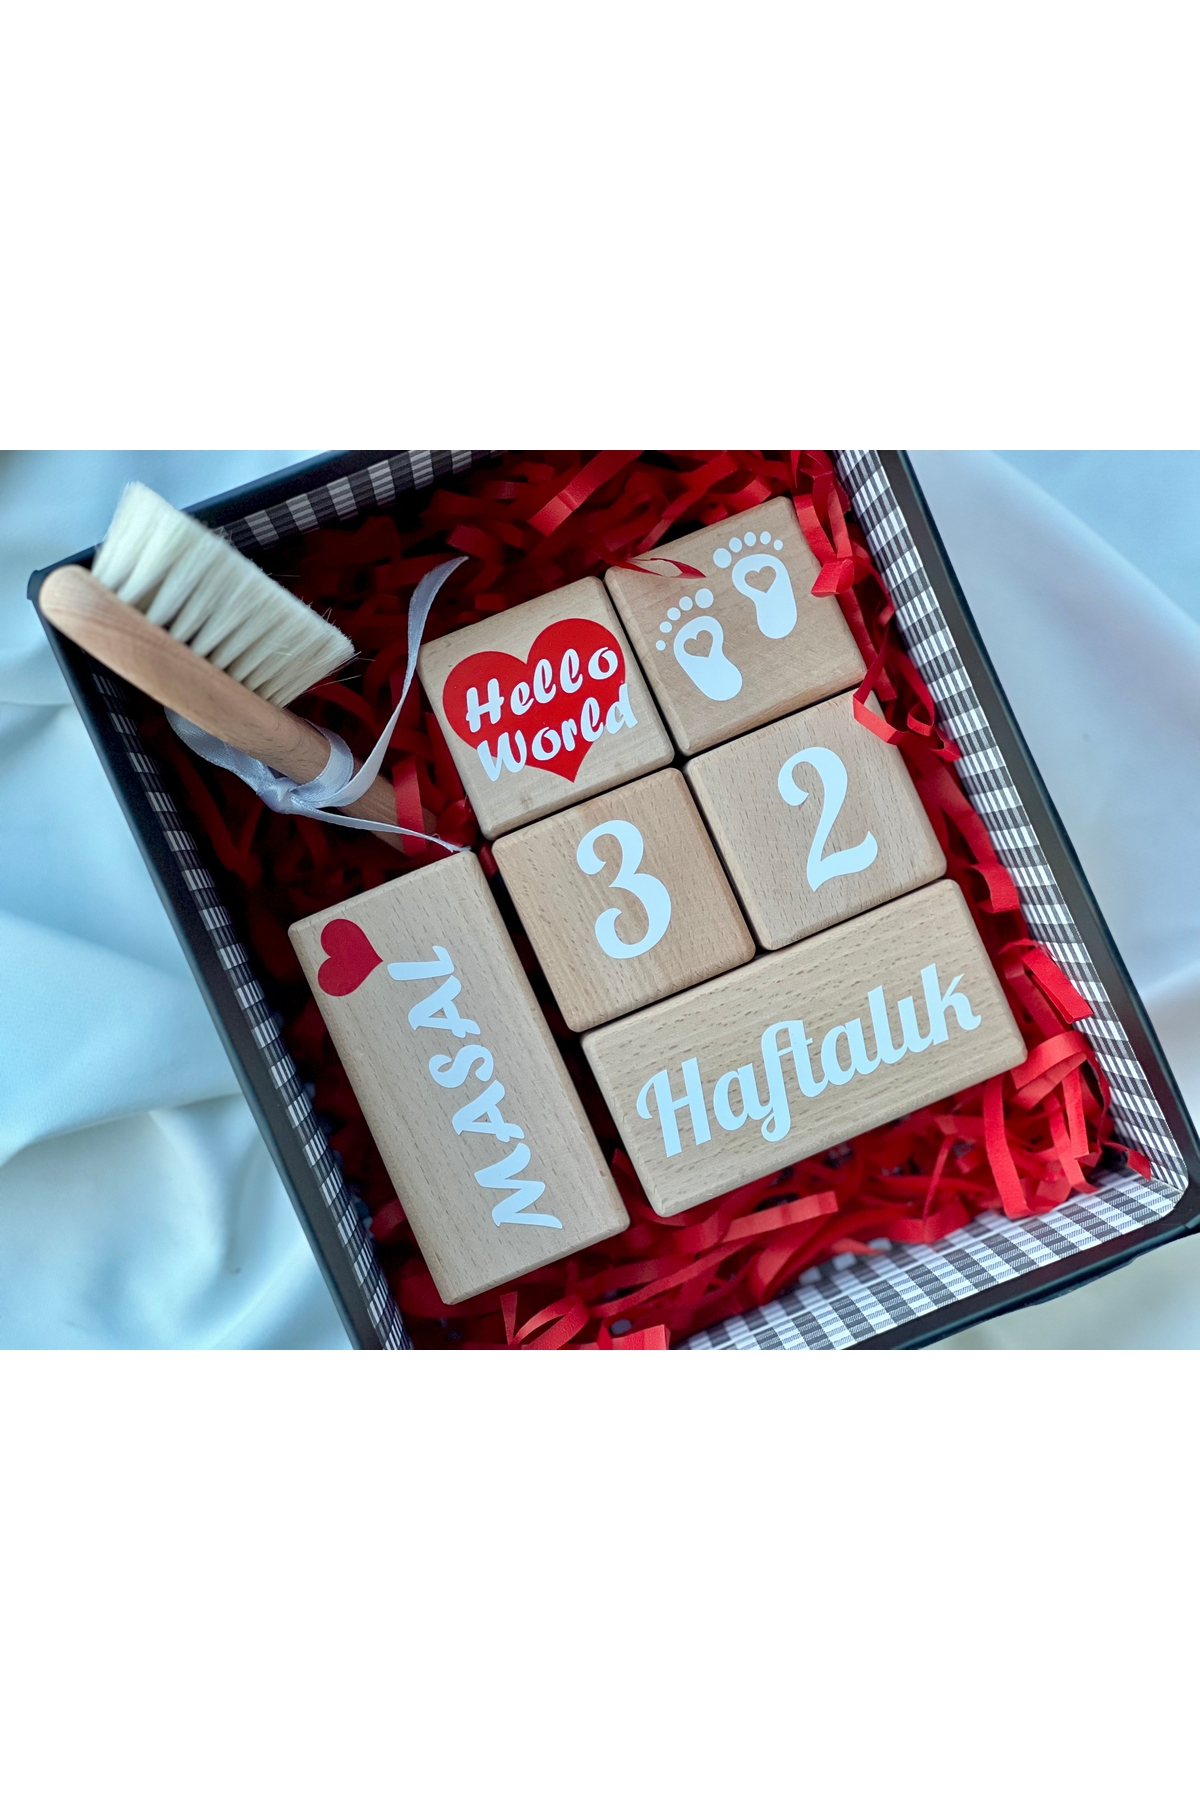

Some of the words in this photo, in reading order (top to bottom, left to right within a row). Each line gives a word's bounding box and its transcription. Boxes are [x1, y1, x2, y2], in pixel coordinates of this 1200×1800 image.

[466, 646, 619, 733] Hello
[477, 683, 639, 782] World
[576, 819, 672, 959] 3
[778, 746, 879, 892] 2
[387, 945, 564, 1230] MASAL
[636, 963, 982, 1158] Haftalık
